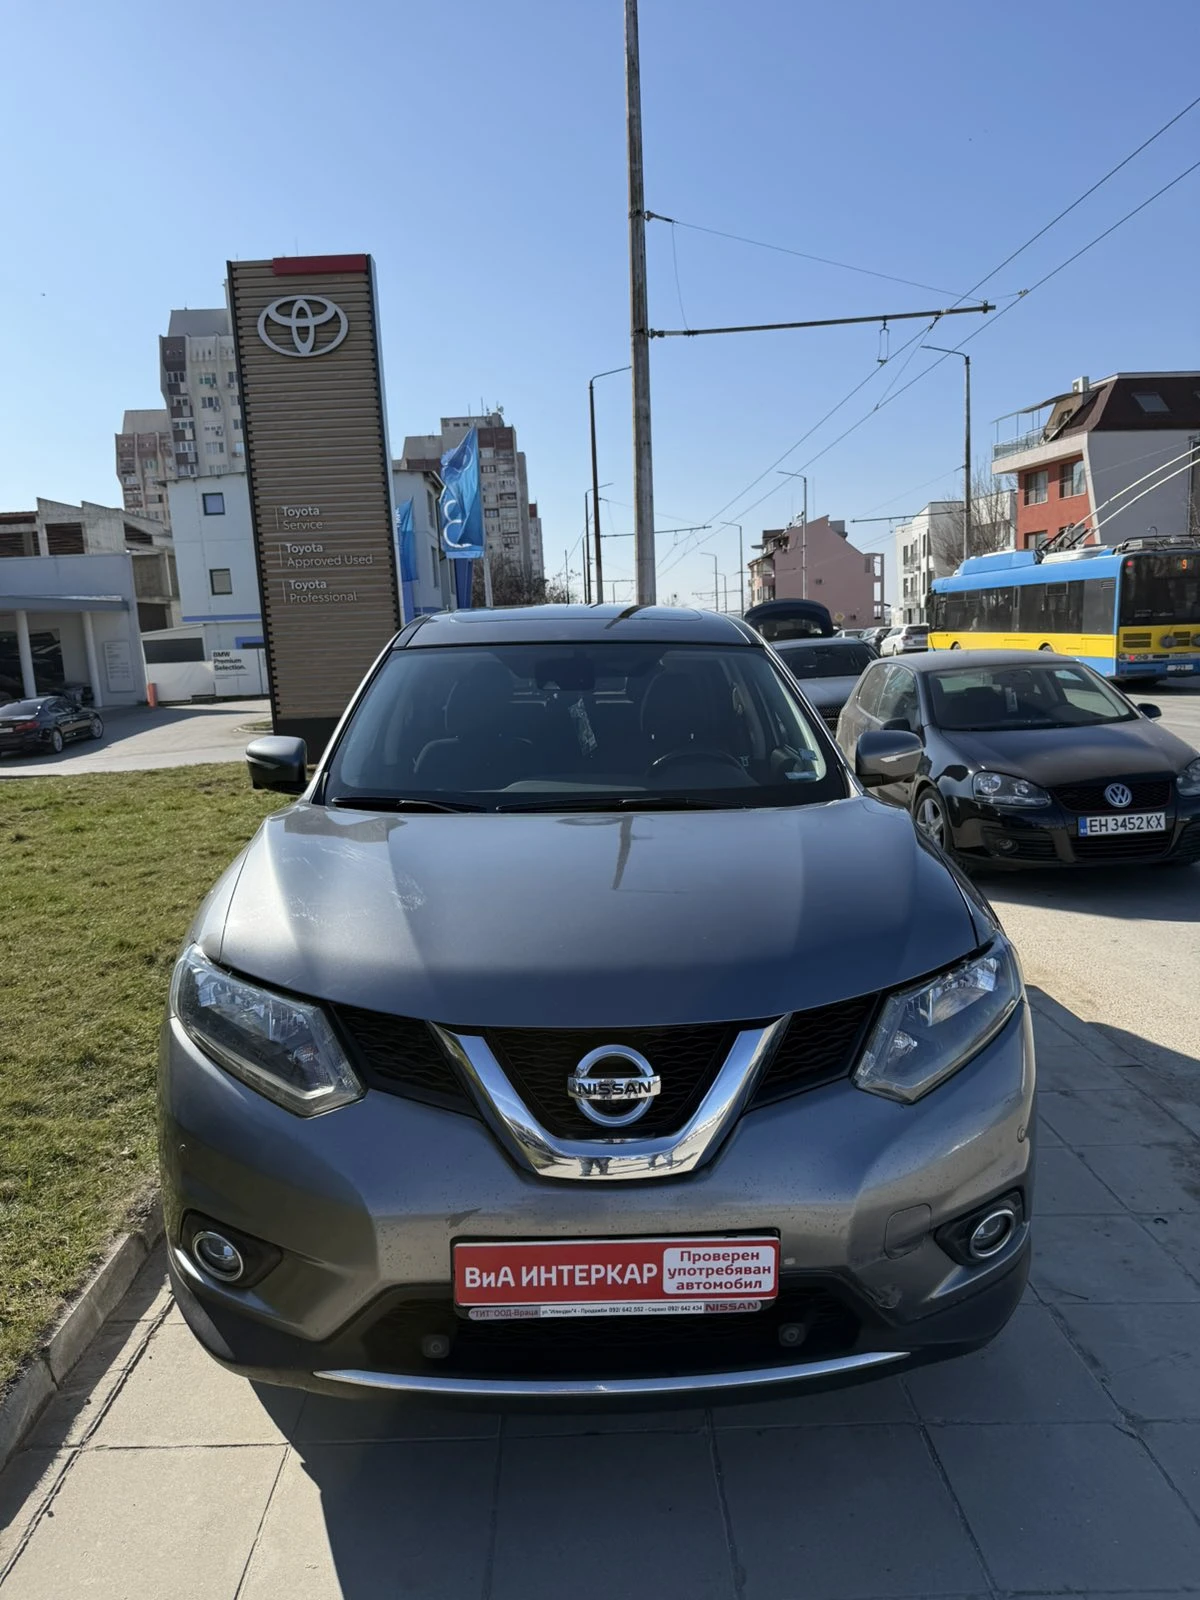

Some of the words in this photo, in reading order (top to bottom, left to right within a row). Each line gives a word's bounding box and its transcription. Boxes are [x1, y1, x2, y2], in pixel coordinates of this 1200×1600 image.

[282, 506, 320, 518] Toyota
[283, 520, 323, 530] Service
[286, 543, 323, 555] Toyota
[287, 556, 341, 568] Approved
[345, 554, 373, 565] Used
[1182, 559, 1188, 569] 9
[289, 580, 327, 591] Toyota
[290, 592, 357, 603] Professional
[214, 657, 242, 665] Premium
[578, 1081, 652, 1095] NISSAN
[680, 1250, 760, 1264] Проверен
[465, 1266, 515, 1288] ВиА
[521, 1263, 658, 1287] ИНТЕРКАР
[668, 1264, 771, 1279] употребяван
[676, 1278, 762, 1290] автомобил
[705, 1301, 758, 1312] NISSAN
